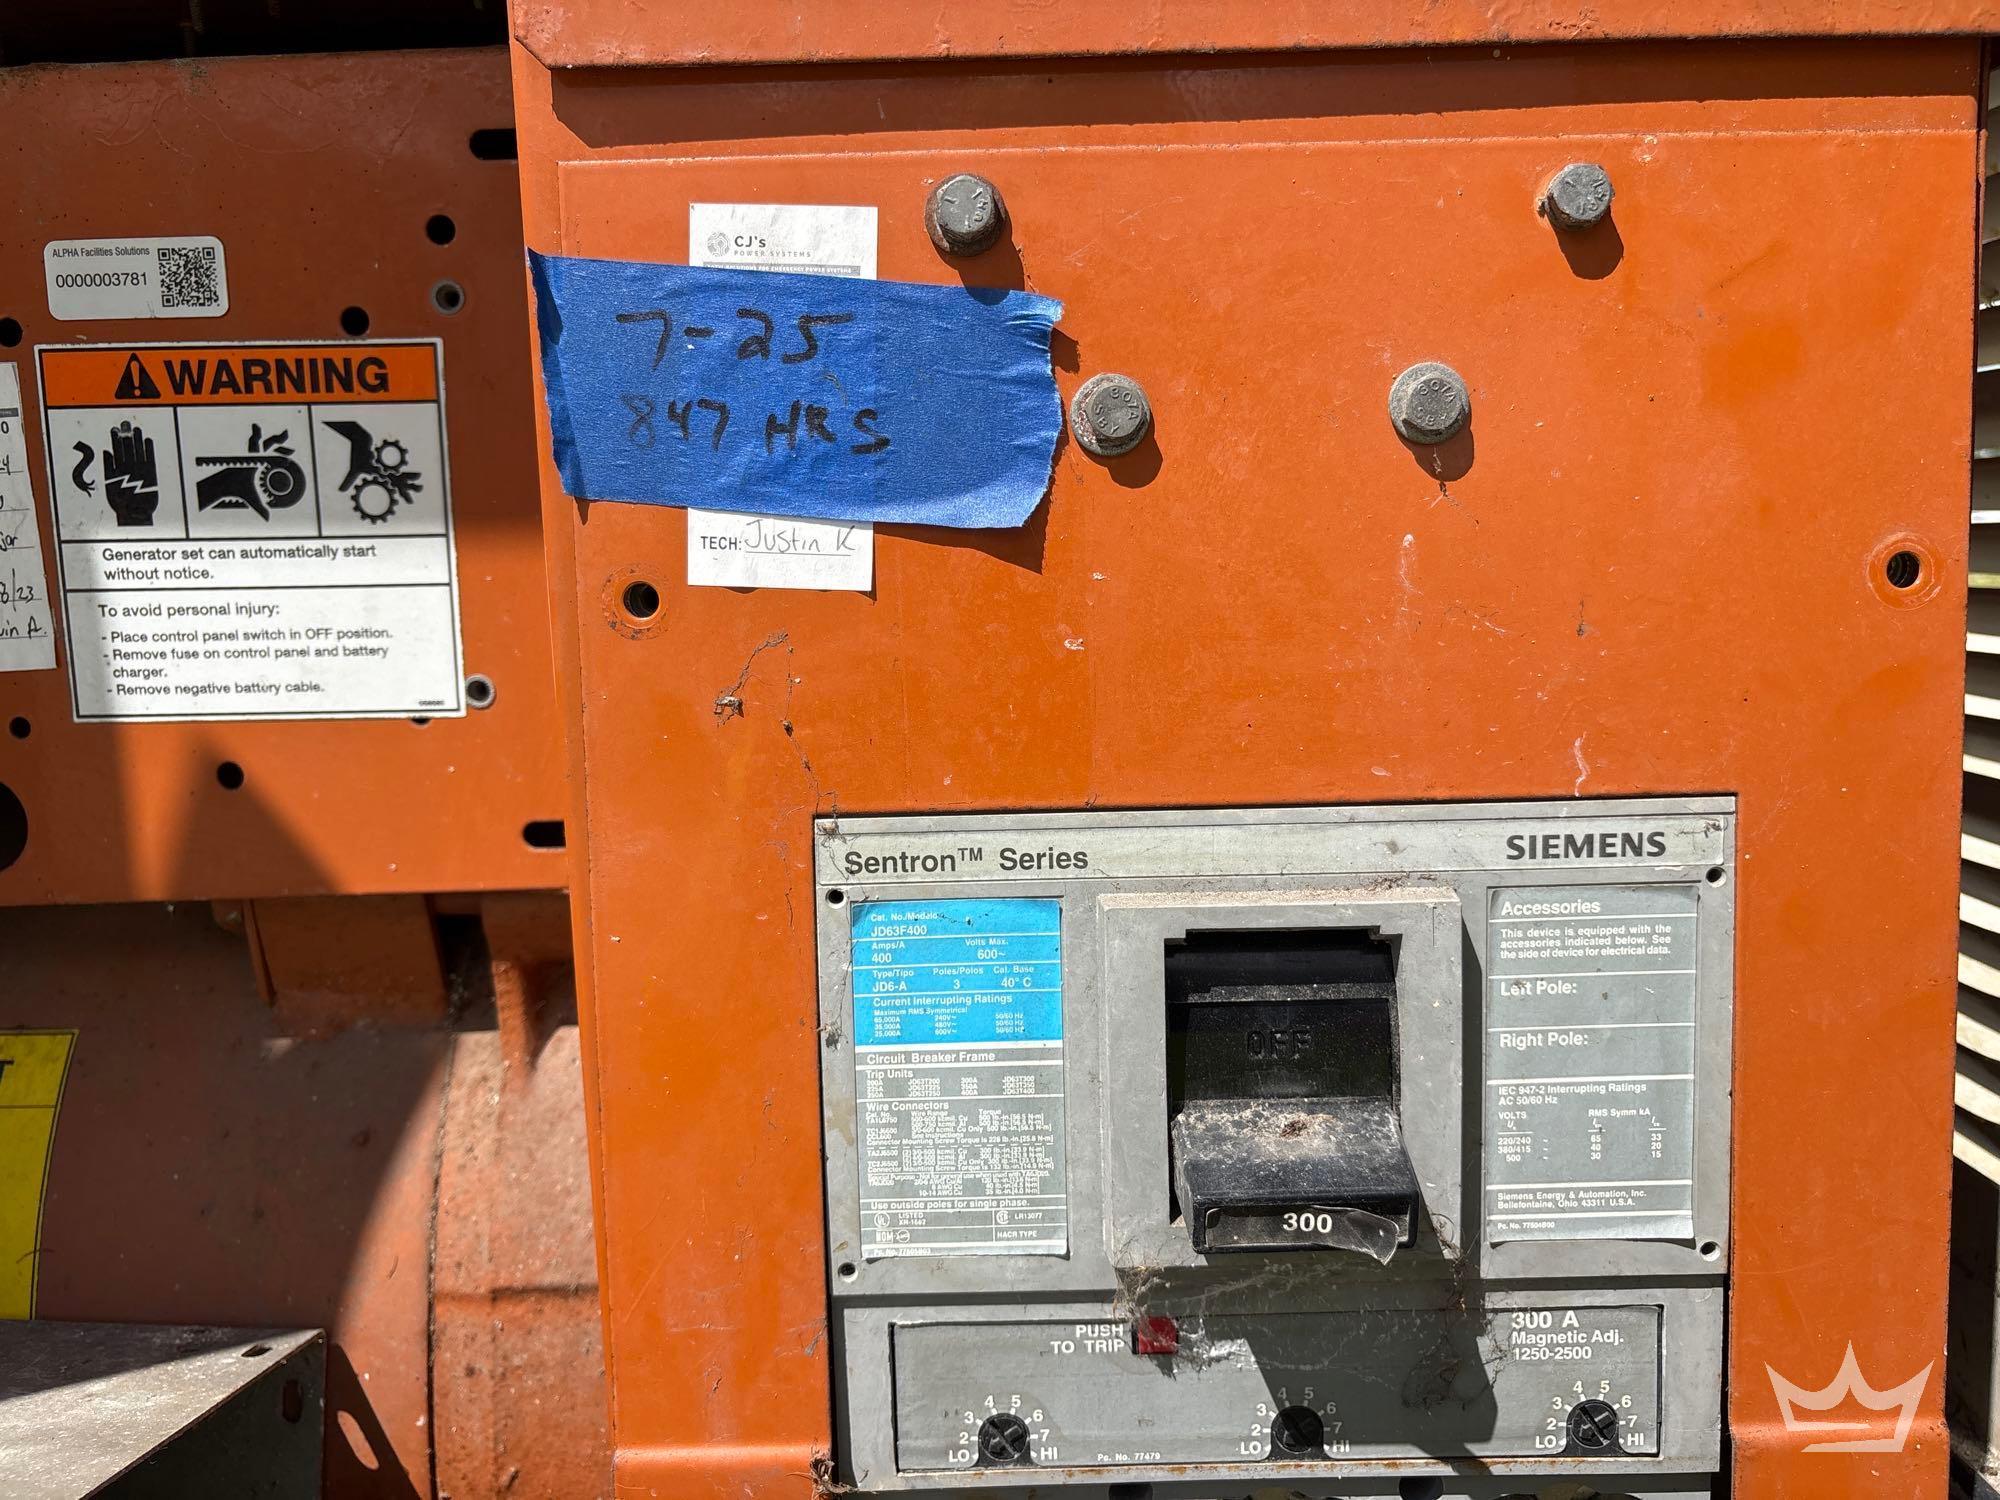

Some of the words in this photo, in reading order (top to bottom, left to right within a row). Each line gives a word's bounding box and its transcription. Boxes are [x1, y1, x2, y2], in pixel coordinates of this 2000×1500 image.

[734, 236, 766, 248] CJ's
[53, 248, 79, 258] ALPHA
[81, 248, 113, 257] Facilities
[115, 246, 150, 256] Solutions
[56, 272, 148, 288] 0000003781
[616, 309, 854, 371] 7-25
[163, 356, 390, 395] WARNING
[620, 393, 730, 454] 847
[764, 400, 892, 454] HRS
[701, 536, 742, 551] TECH:
[836, 525, 856, 551] K
[102, 548, 177, 561] Generator
[182, 548, 204, 560] set
[208, 549, 236, 560] can
[240, 545, 340, 561] automatically
[343, 544, 377, 558] start
[104, 567, 160, 581] without
[164, 567, 214, 580] notice.
[98, 604, 118, 618] To
[122, 604, 163, 617] avoid
[167, 604, 231, 619] personal
[235, 604, 280, 618] injury:
[111, 631, 148, 644] Place
[152, 630, 198, 643] control
[203, 630, 239, 643] panel
[243, 629, 286, 641] switch
[290, 628, 301, 640] in
[306, 628, 333, 640] OFF
[336, 627, 393, 641] position.
[112, 648, 167, 661] Remove
[171, 648, 199, 660] fuse
[204, 649, 220, 660] on
[224, 647, 270, 659] control
[274, 646, 310, 660] panel
[315, 646, 339, 658] and
[343, 645, 389, 658] battery
[113, 666, 168, 680] charger.
[116, 684, 171, 696] Remove
[174, 684, 231, 697] negative
[235, 682, 280, 696] battery
[285, 682, 325, 694] cable.
[1506, 832, 1667, 860] SIEMENS
[1000, 846, 1089, 871] Series
[1501, 899, 1600, 916] Accessories
[870, 925, 927, 937] JD63F400
[1500, 929, 1523, 938] This
[1527, 928, 1560, 937] device
[1564, 927, 1574, 936] is
[1578, 926, 1625, 937] equipped
[1629, 925, 1651, 934] with
[1655, 924, 1672, 933] the
[872, 941, 905, 950] Amps/A
[989, 938, 1008, 946] Max.
[1500, 938, 1560, 949] accessories
[1565, 936, 1611, 946] indicated
[1615, 936, 1647, 944] below.
[1652, 935, 1671, 944] See
[872, 953, 892, 963] 400
[1500, 950, 1516, 959] the
[1518, 949, 1538, 958] side
[1540, 949, 1551, 958] of
[1552, 948, 1583, 957] device
[1586, 947, 1599, 956] for
[1601, 946, 1645, 956] electrical
[1647, 946, 1671, 954] data.
[873, 970, 914, 979] Type/Tipo
[933, 967, 984, 975] Poles/Polos
[872, 981, 907, 992] JD6-A
[1536, 980, 1577, 994] Pole:
[873, 998, 911, 1007] Current
[913, 996, 972, 1005] Interrupting
[974, 994, 1012, 1004] Ratings
[1248, 1031, 1312, 1060] OFF
[1500, 1033, 1543, 1050] Right
[1548, 1031, 1588, 1046] Pole:
[867, 1054, 905, 1064] Circuit
[911, 1052, 956, 1063] Breaker
[959, 1052, 996, 1062] Frame
[866, 1070, 884, 1079] Trip
[888, 1070, 913, 1078] Units
[1498, 1086, 1516, 1095] IEC
[1519, 1086, 1545, 1095] 947-2
[1548, 1084, 1606, 1094] Interrupting
[1608, 1083, 1647, 1093] Ratings
[866, 1103, 889, 1111] Wire
[892, 1102, 949, 1110] Connectors
[1498, 1097, 1514, 1106] AC
[1516, 1096, 1542, 1105] 50/60
[1545, 1095, 1558, 1104] Hz
[1498, 1111, 1526, 1119] VOLTS
[1588, 1109, 1607, 1117] RMS
[1610, 1108, 1636, 1118] Symm
[1498, 1192, 1533, 1200] Siemens
[1536, 1192, 1566, 1201] Energy
[1569, 1191, 1576, 1199] &
[1578, 1190, 1628, 1199] Automation,
[871, 1202, 888, 1210] Use
[891, 1200, 924, 1209] outside
[927, 1200, 952, 1210] poles
[954, 1200, 967, 1208] for
[970, 1200, 997, 1209] single
[1000, 1200, 1030, 1209] phase.
[1498, 1200, 1555, 1209] Bellefontaine,
[1558, 1200, 1578, 1208] Ohio
[1582, 1199, 1605, 1207] 43311
[1283, 1212, 1332, 1233] 300
[1512, 1311, 1552, 1329] 300
[1562, 1310, 1579, 1328] A
[1076, 1324, 1124, 1338] PUSH
[1512, 1330, 1587, 1346] Magnetic
[1591, 1330, 1624, 1346] Adj.
[1050, 1341, 1075, 1354] TO
[1083, 1340, 1125, 1353] TRIP
[1514, 1346, 1592, 1360] 1250-2500
[1278, 1387, 1287, 1399] 4
[1304, 1387, 1314, 1399] 5
[1573, 1381, 1583, 1393] 4
[1600, 1380, 1610, 1393] 5
[984, 1395, 994, 1408] 4
[1011, 1395, 1021, 1407] 5
[1552, 1397, 1562, 1410] 3
[1621, 1395, 1632, 1408] 6
[1256, 1403, 1266, 1416] 3
[1327, 1402, 1336, 1414] 6
[964, 1412, 974, 1424] 3
[1033, 1410, 1044, 1422] 6
[1627, 1416, 1637, 1428] 7
[1251, 1424, 1261, 1436] 2
[1333, 1422, 1342, 1434] 7
[1546, 1418, 1556, 1430] 2
[960, 1432, 969, 1444] 2
[1041, 1429, 1050, 1441] 7
[1627, 1433, 1644, 1446] HI
[1240, 1441, 1262, 1454] LO
[1333, 1440, 1350, 1452] HI
[1536, 1436, 1556, 1449] LO
[949, 1449, 970, 1462] LO
[1041, 1447, 1058, 1460] HI
[1098, 1453, 1110, 1461] Pc.
[1115, 1453, 1131, 1461] No.
